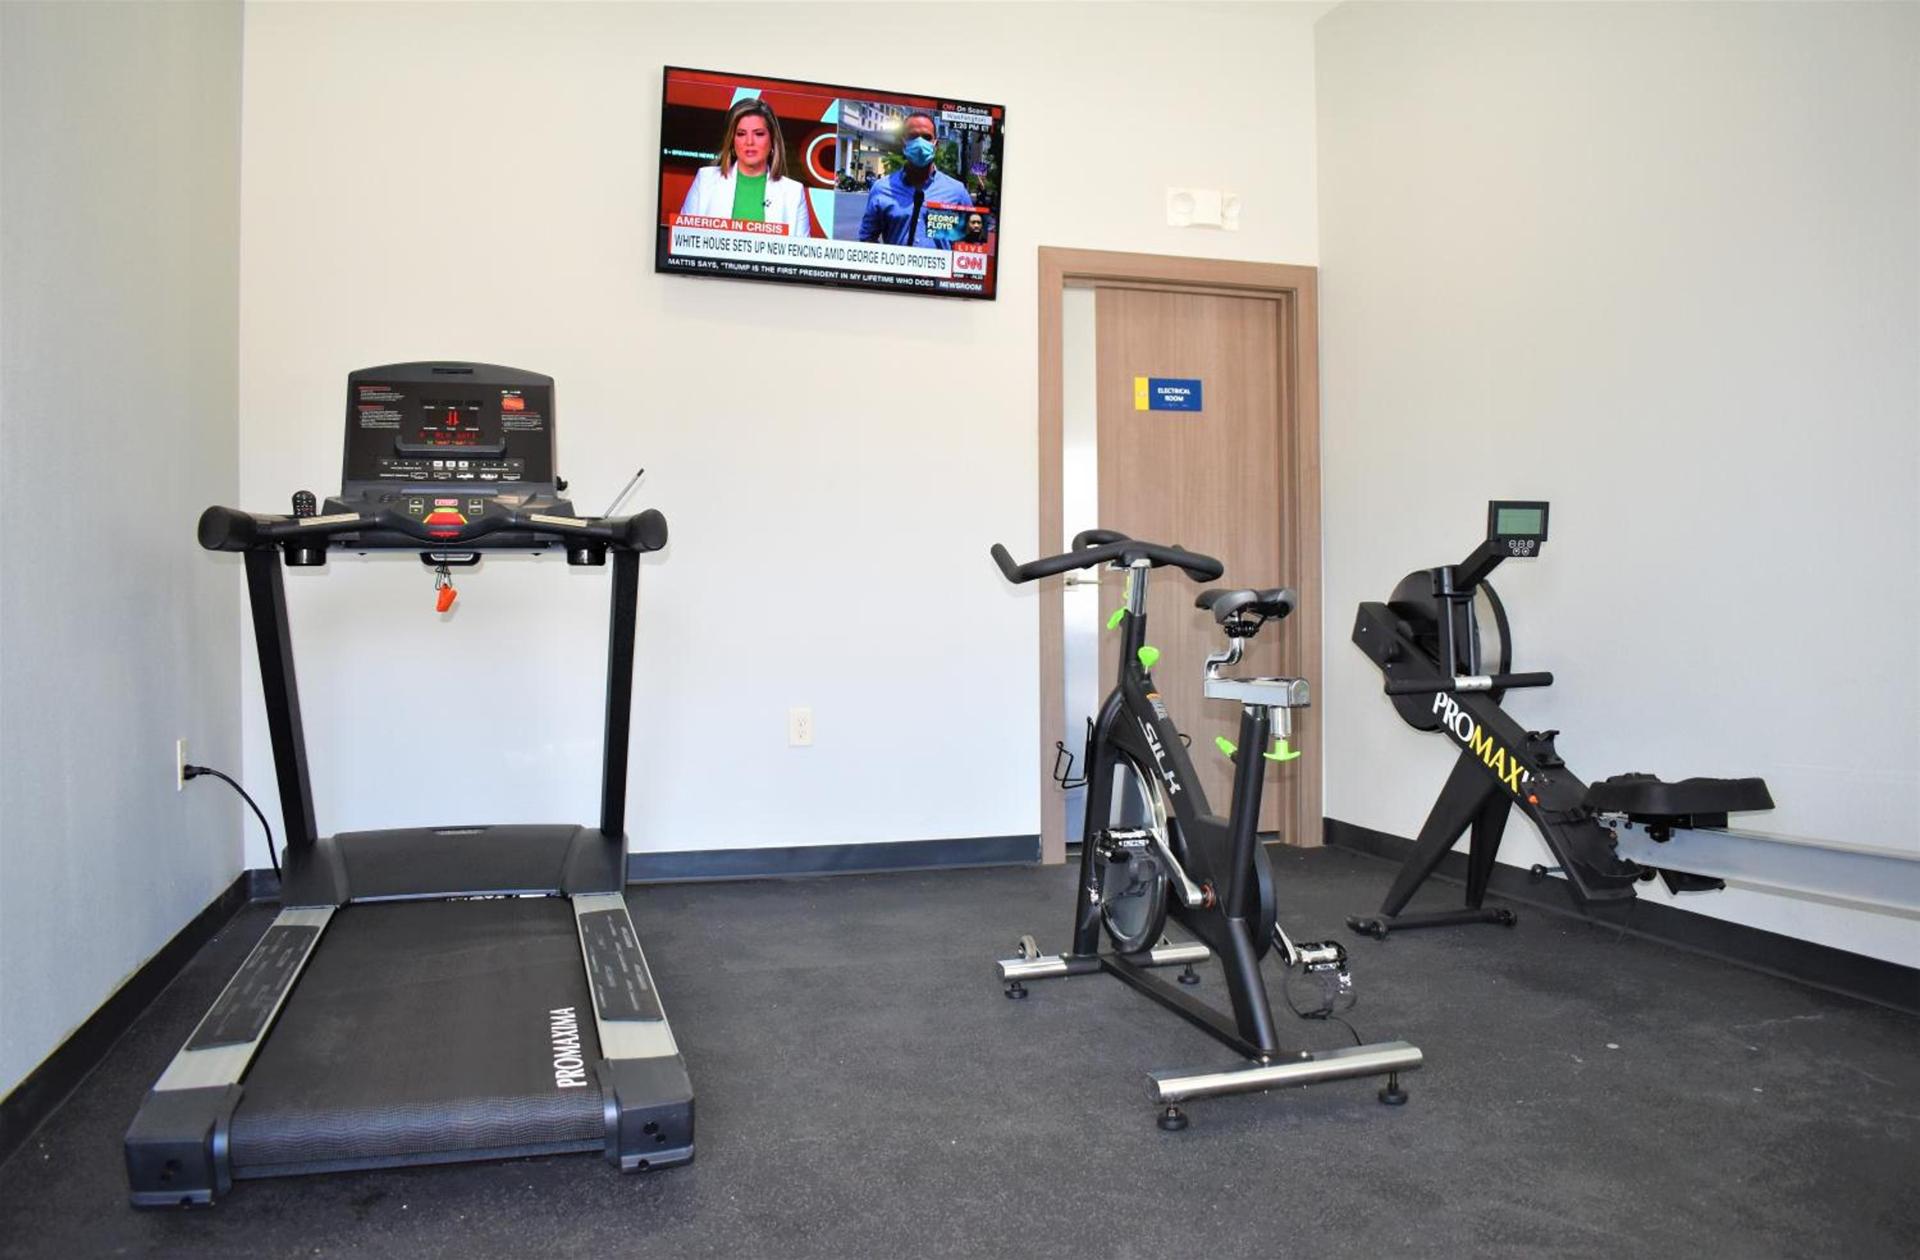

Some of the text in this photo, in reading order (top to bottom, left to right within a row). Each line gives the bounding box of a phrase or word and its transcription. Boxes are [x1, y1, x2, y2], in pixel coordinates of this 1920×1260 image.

[676, 216, 783, 234] AMERICA IN CRISIS
[927, 214, 959, 225] GEORGE
[927, 222, 953, 231] FLOYD
[674, 234, 946, 270] WHITE HOUSE SETS UP NEW FENCING AMID GEORGE FLOYD PROTESTS
[957, 256, 983, 270] CNN
[668, 258, 695, 267] MATTIS
[697, 260, 719, 269] SAYS,
[761, 265, 776, 274] THE
[777, 267, 797, 275] FIRST
[799, 269, 839, 278] PRESIDENT
[841, 271, 848, 279] IN
[850, 272, 861, 281] MY
[863, 273, 894, 284] LIFETIME
[896, 276, 913, 285] WHO
[915, 278, 934, 287] DOES
[939, 280, 982, 291] NEWSROOM
[1157, 387, 1191, 395] ELECTRICAL
[1432, 692, 1530, 793] PROMAX
[1137, 716, 1181, 795] SILK
[549, 1006, 588, 1088] PROMAXIMA
